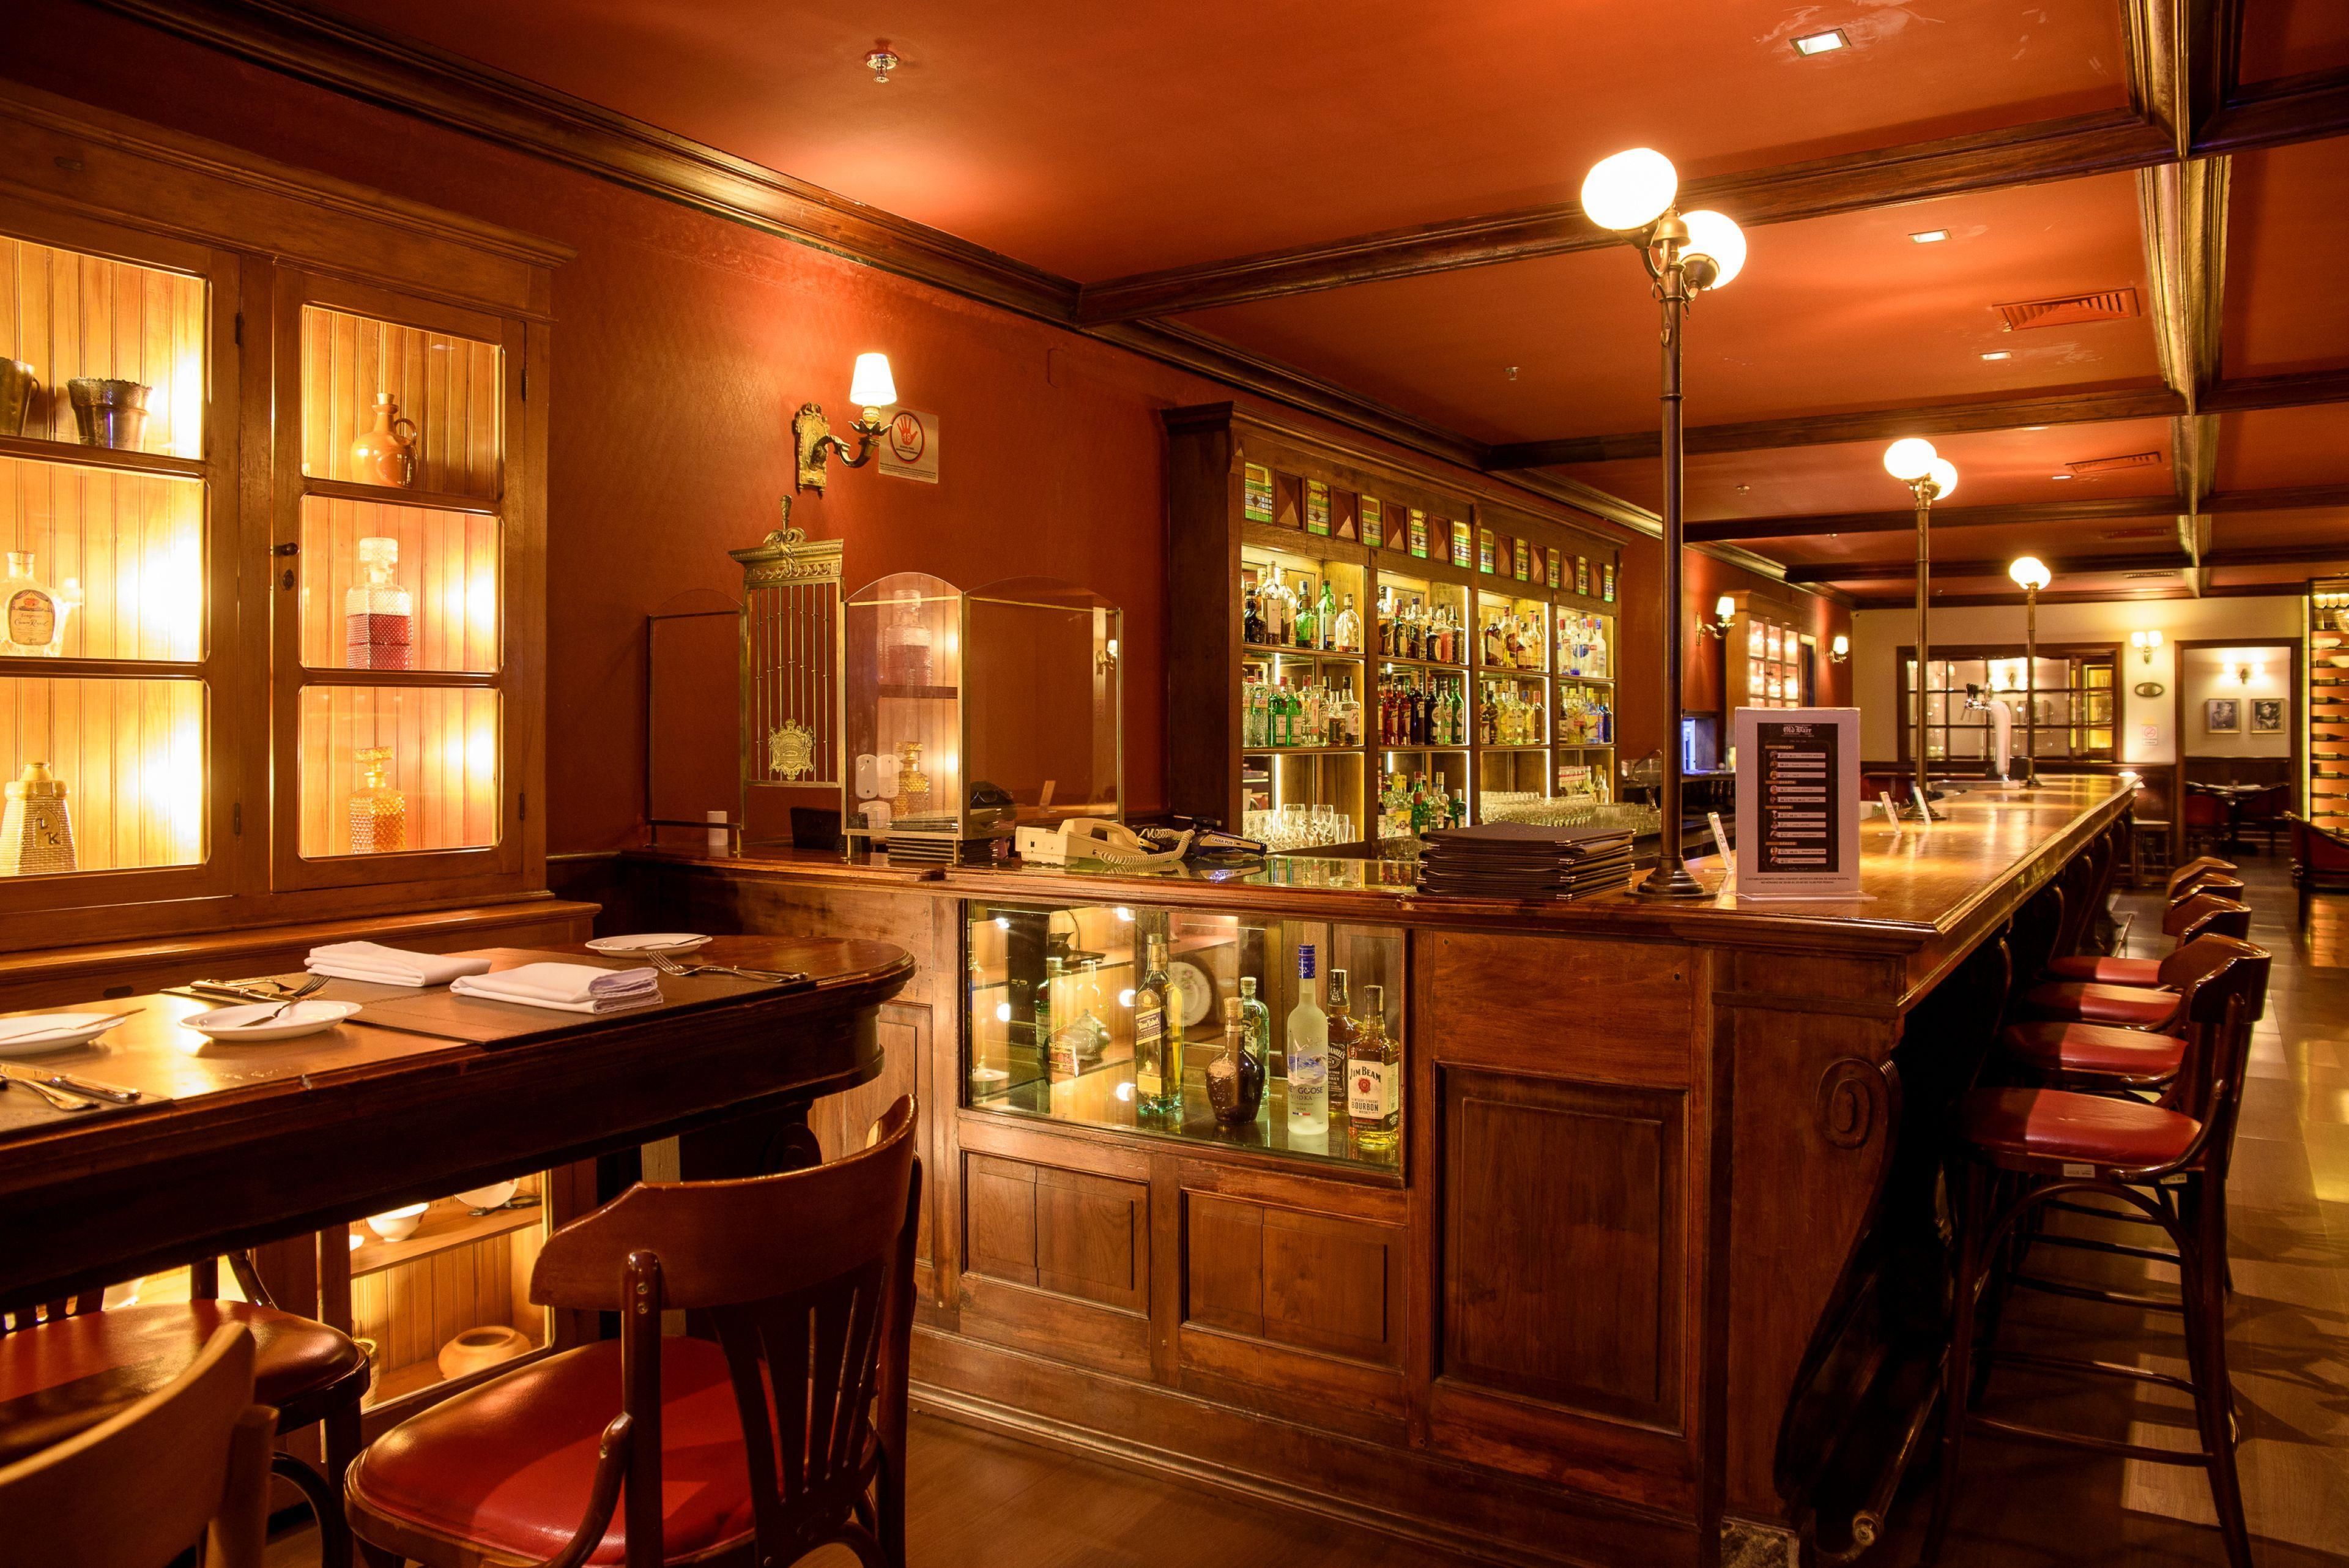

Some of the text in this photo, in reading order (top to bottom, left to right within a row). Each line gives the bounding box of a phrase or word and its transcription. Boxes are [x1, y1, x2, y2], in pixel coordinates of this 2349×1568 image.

[44, 831, 61, 845] K
[1349, 1066, 1381, 1083] JIM BEAM
[1351, 1101, 1379, 1112] BOURBON
